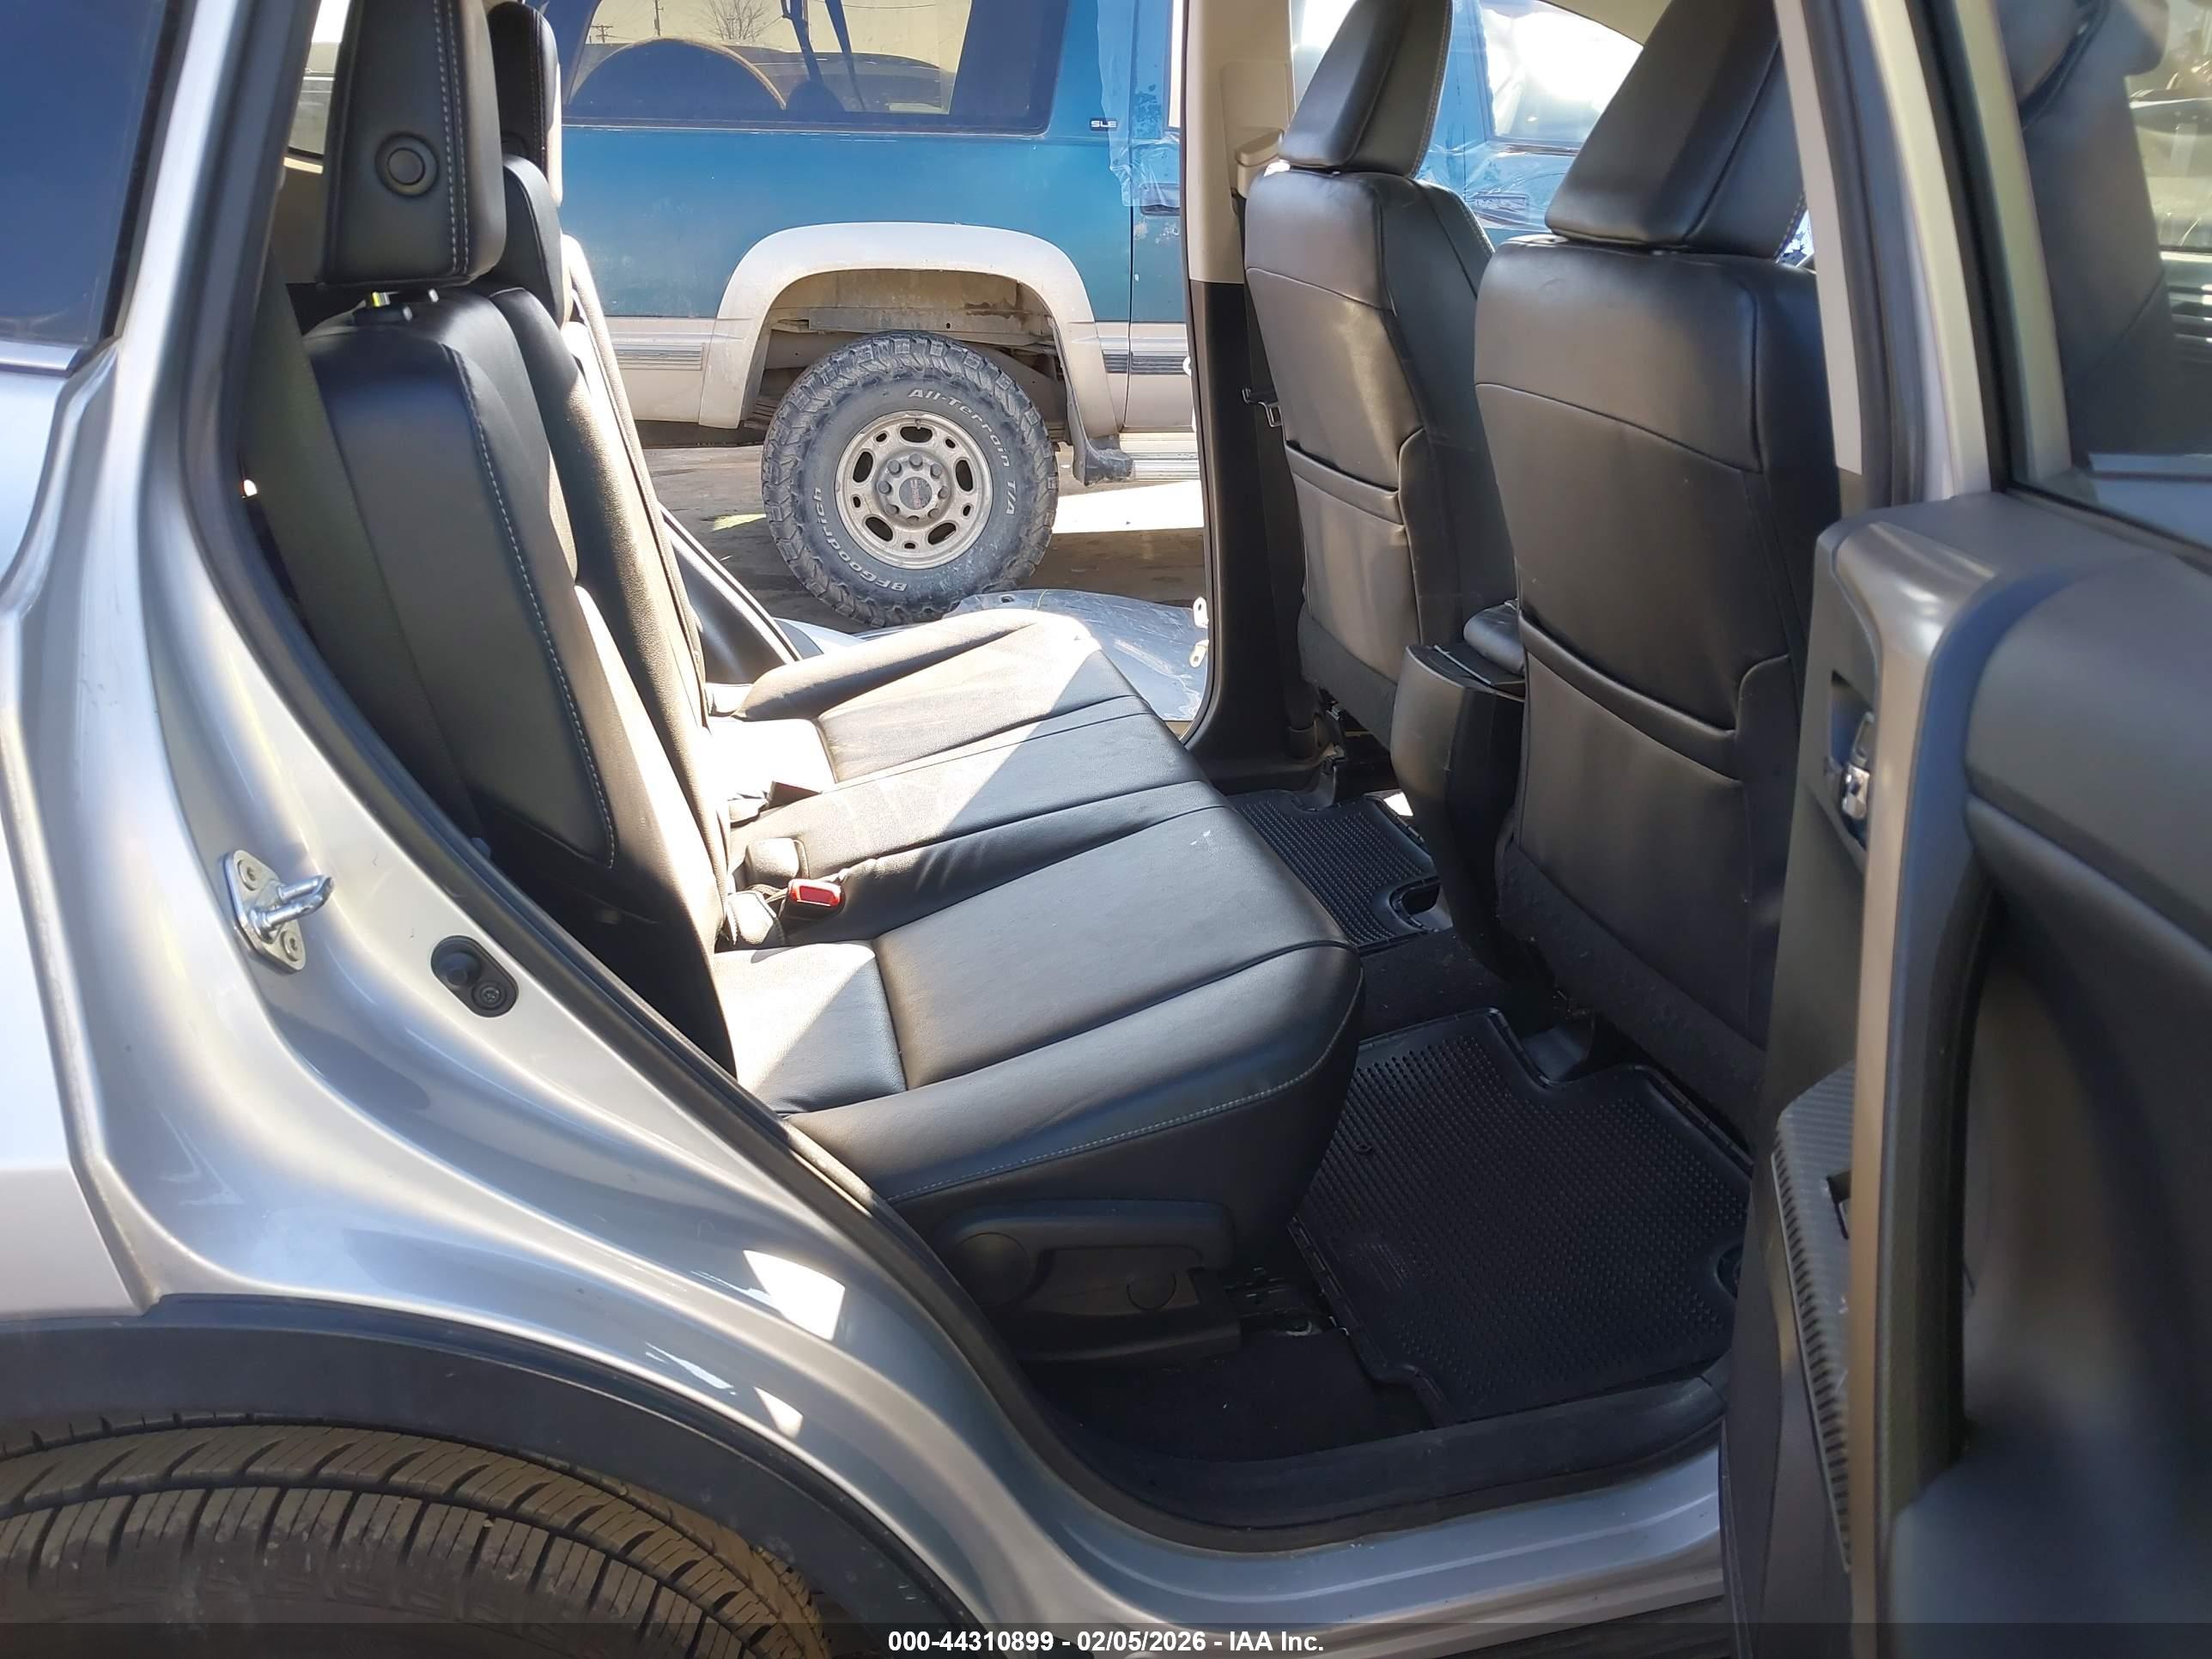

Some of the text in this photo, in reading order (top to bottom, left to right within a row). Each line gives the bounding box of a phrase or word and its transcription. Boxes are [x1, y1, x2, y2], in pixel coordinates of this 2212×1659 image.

[907, 388, 1018, 515] All-Terrain T/A
[812, 486, 908, 592] BFGoodrich
